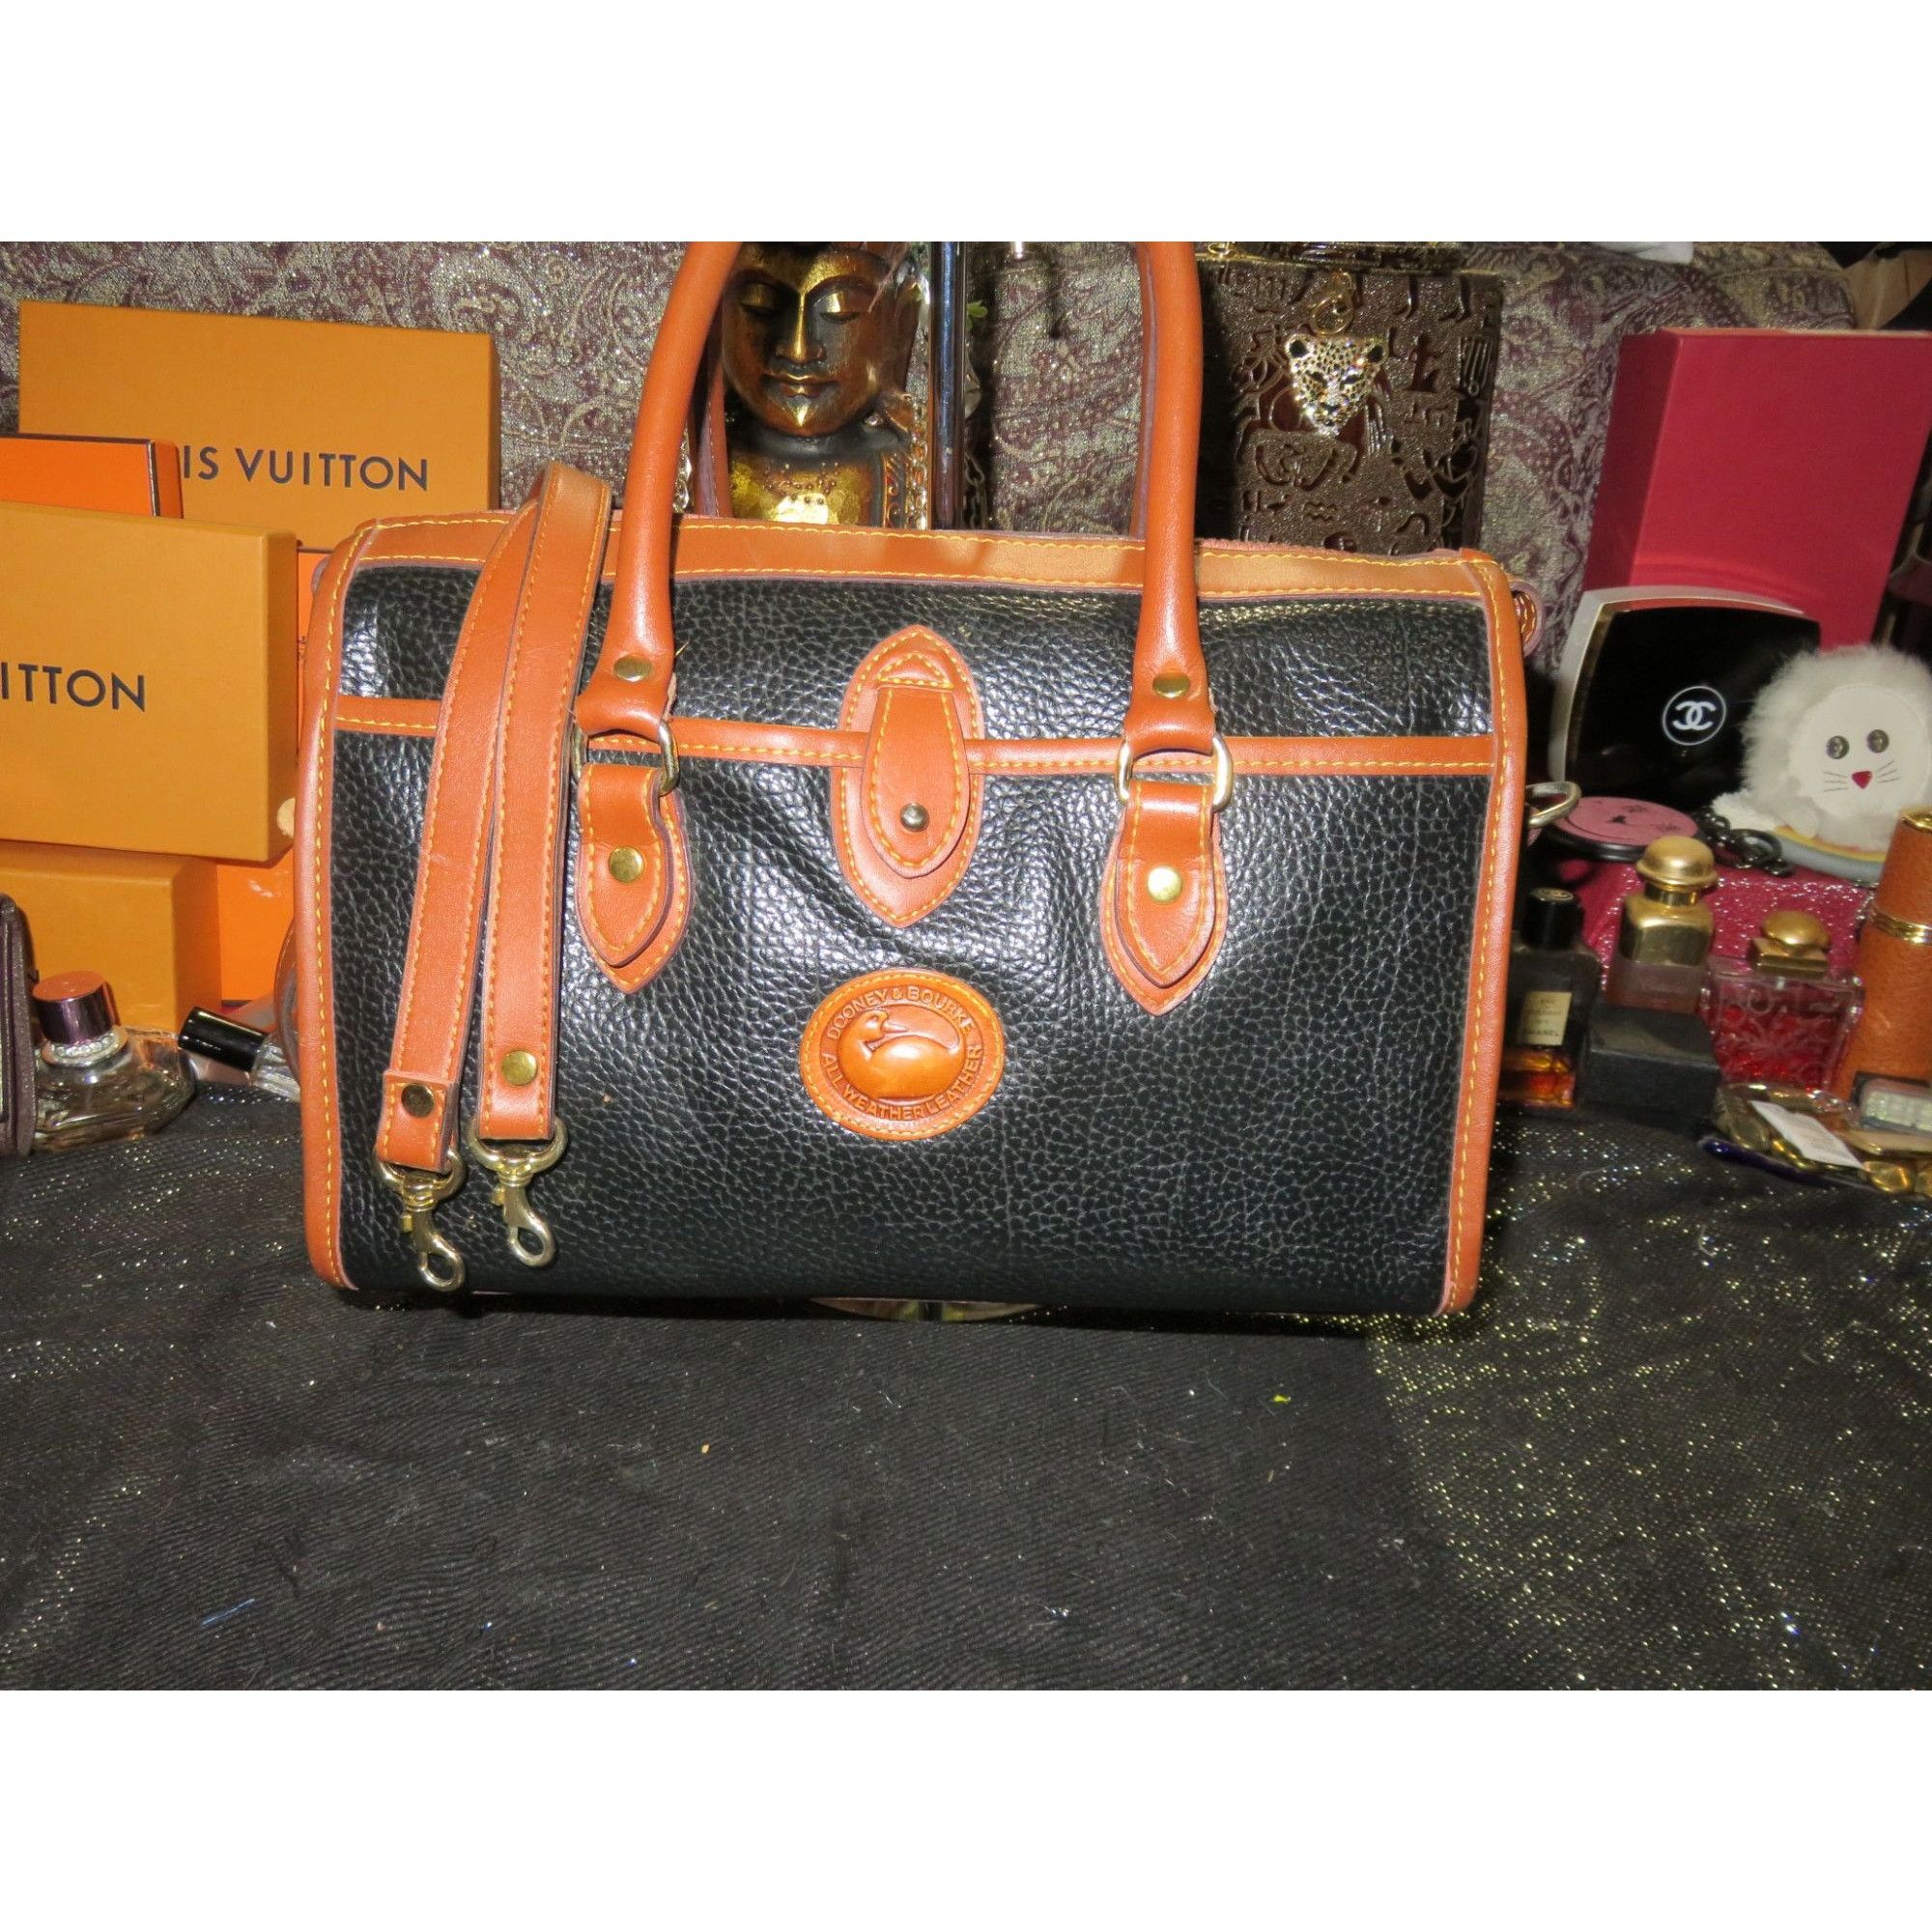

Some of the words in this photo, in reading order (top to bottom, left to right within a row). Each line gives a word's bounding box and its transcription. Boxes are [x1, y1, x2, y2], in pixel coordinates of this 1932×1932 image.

[235, 447, 427, 492] VUITTON
[827, 987, 888, 1040] DOONEY
[892, 988, 905, 1000] &
[907, 985, 976, 1036] BOURKE
[821, 1052, 843, 1089] ALL
[842, 1083, 926, 1121] WEATHER
[926, 1044, 982, 1116] LEATHER
